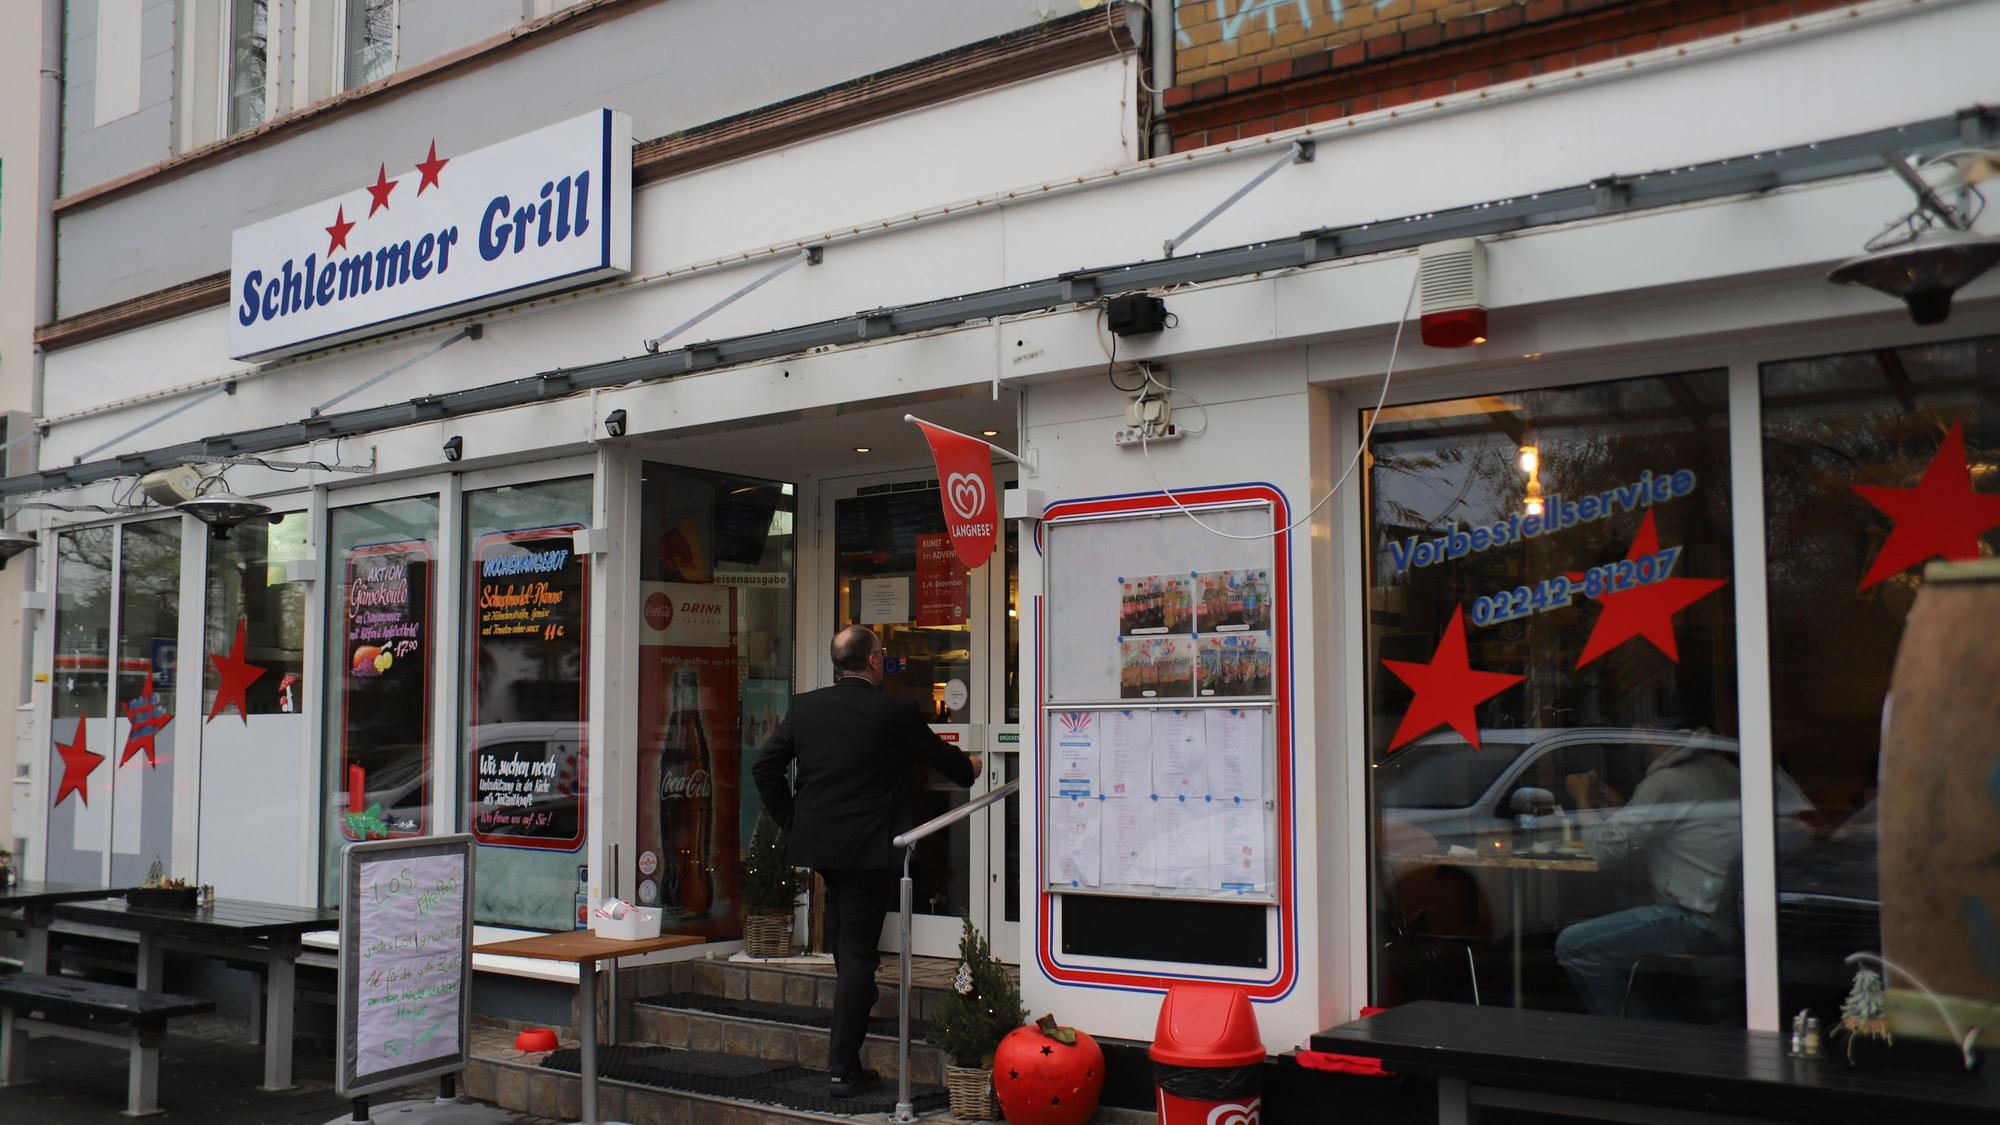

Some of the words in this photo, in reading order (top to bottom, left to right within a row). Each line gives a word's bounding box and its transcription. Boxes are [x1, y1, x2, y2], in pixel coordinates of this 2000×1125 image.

[239, 223, 458, 326] Schlemmer
[479, 169, 591, 262] Grill
[952, 524, 990, 537] LANGNESE
[1388, 468, 1697, 574] Vorbestellservice
[367, 564, 404, 582] AKTION
[483, 549, 568, 578] WOCHENANGEBOT
[712, 574, 786, 586] eisenausgabe
[1471, 544, 1684, 628] 02242-81207
[349, 577, 408, 619] Gänsekeule
[681, 602, 721, 615] DRINK
[480, 754, 496, 775] Wir
[499, 752, 529, 777] suchen
[532, 754, 556, 778] noch
[660, 768, 711, 801] Coca-Cola
